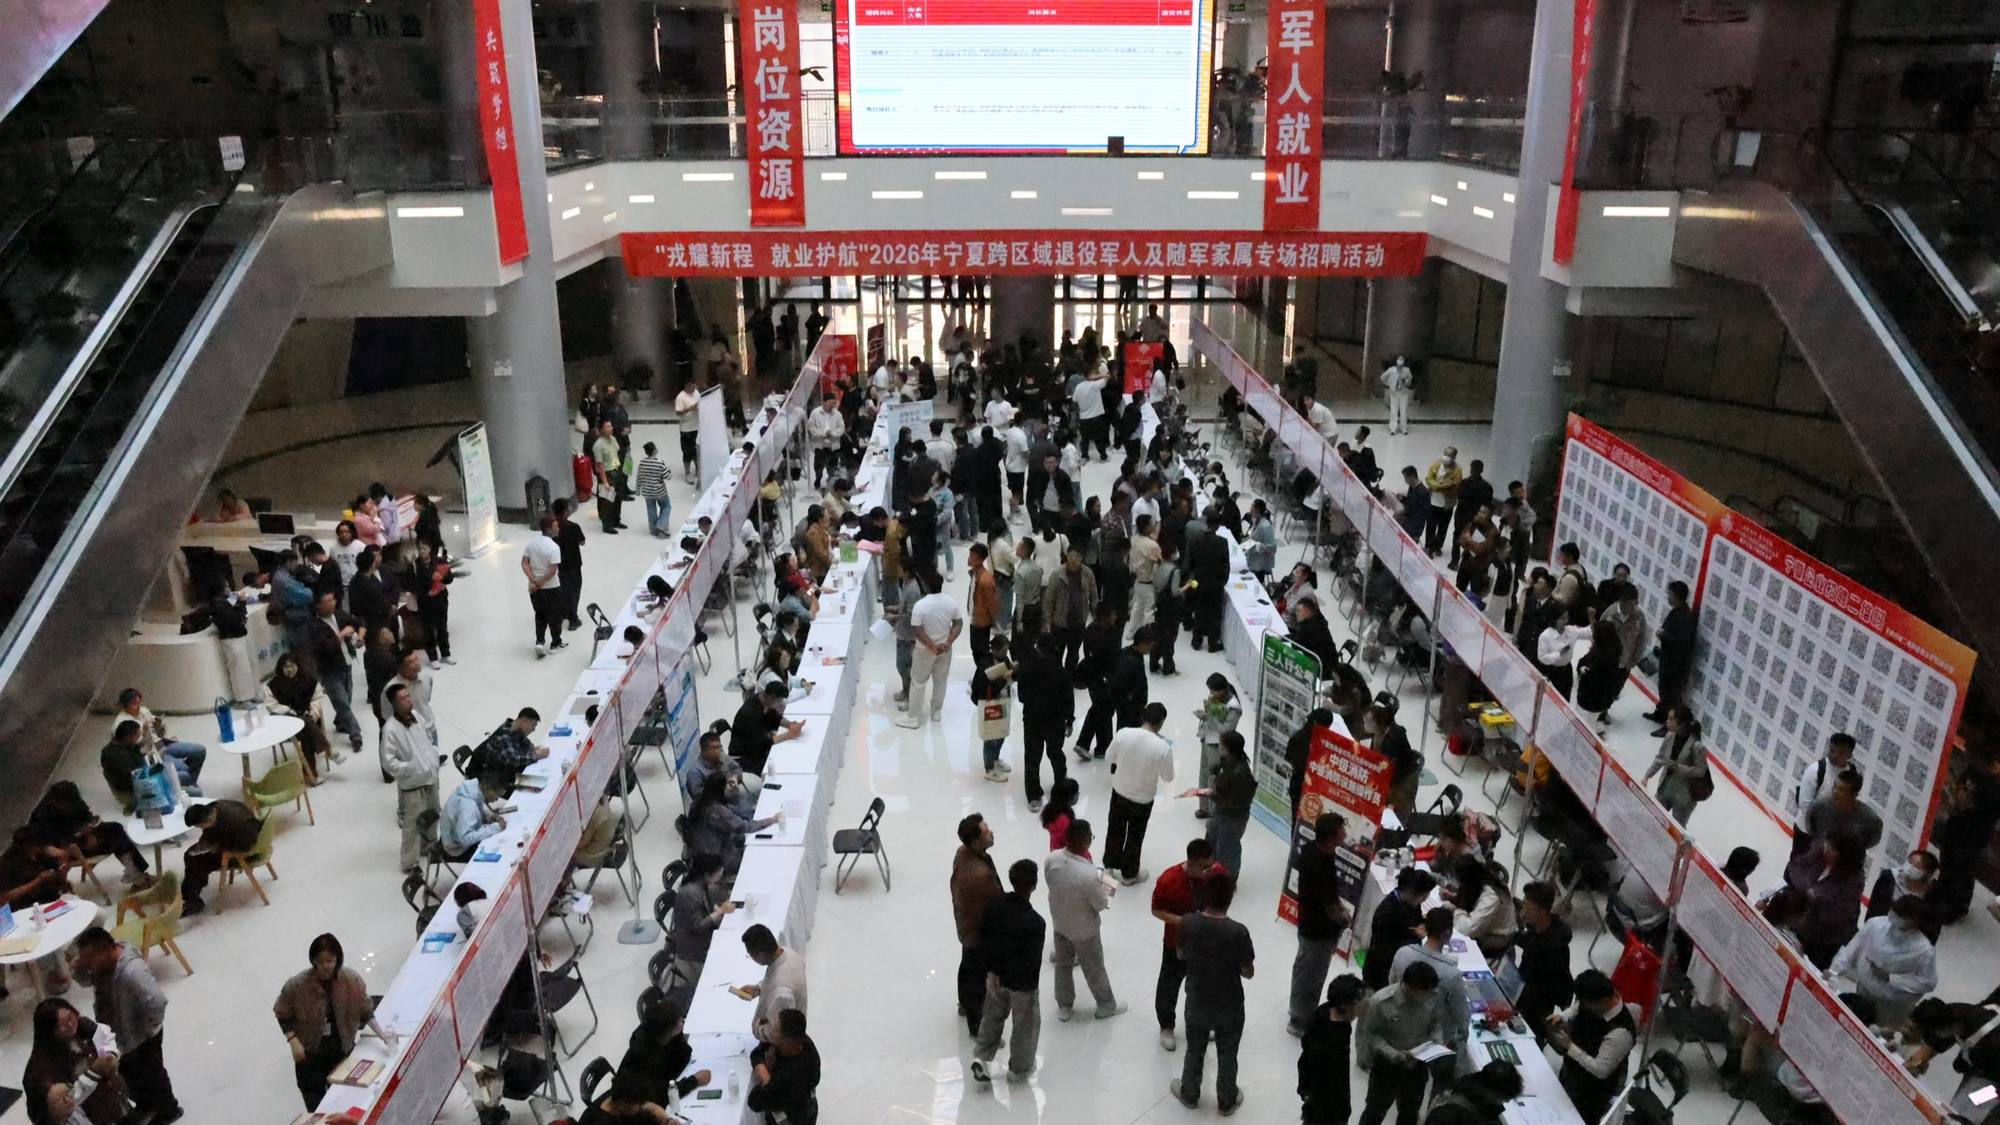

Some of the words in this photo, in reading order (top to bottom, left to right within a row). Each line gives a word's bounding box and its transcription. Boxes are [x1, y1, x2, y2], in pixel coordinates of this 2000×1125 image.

[754, 6, 794, 200] 岗位资源
[1275, 0, 1314, 203] 军人就业
[1329, 753, 1370, 784] 中级消防
